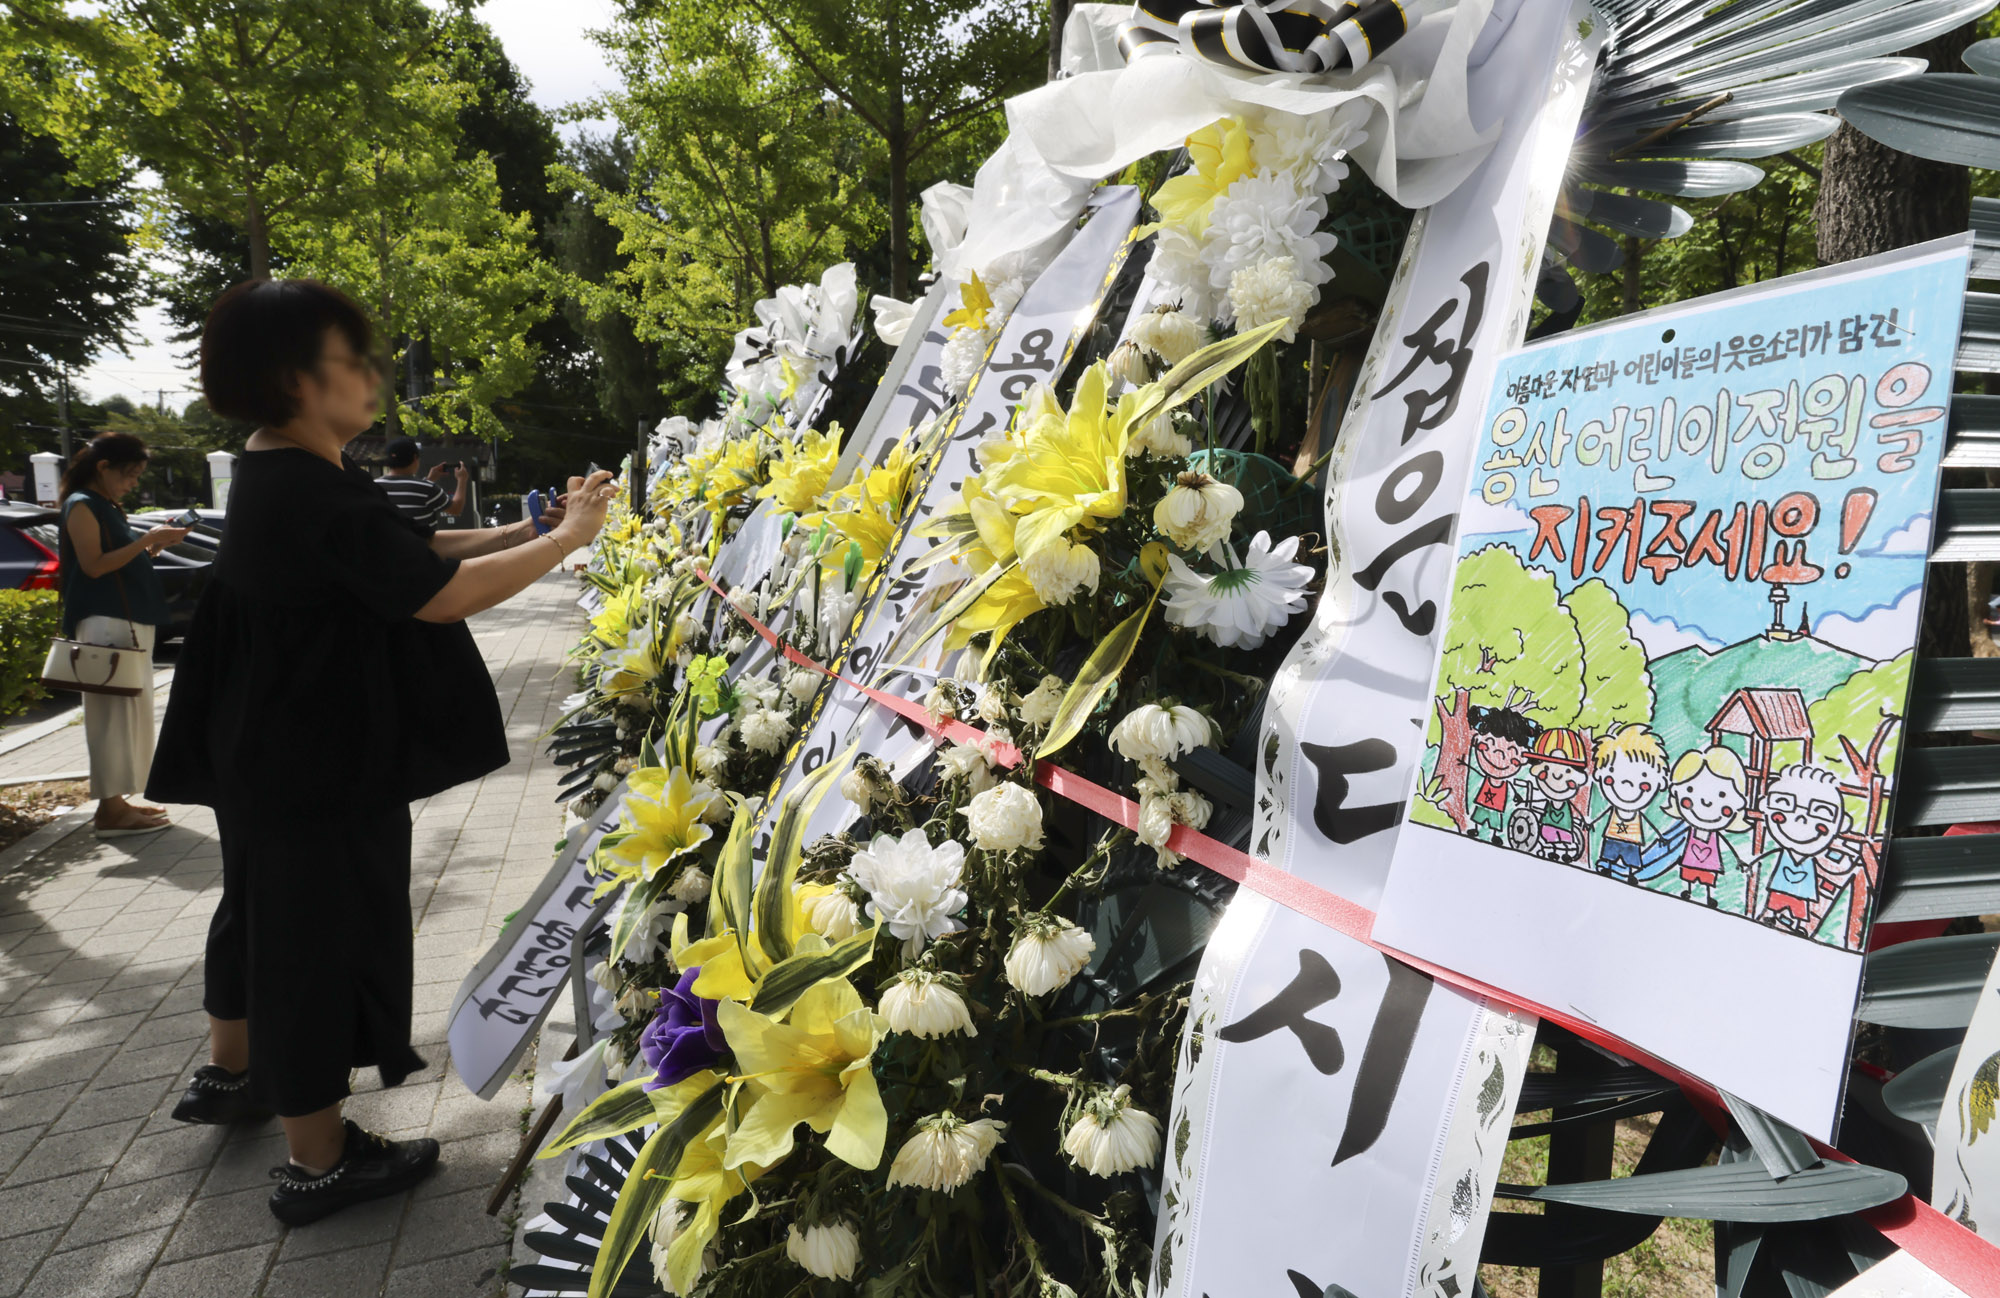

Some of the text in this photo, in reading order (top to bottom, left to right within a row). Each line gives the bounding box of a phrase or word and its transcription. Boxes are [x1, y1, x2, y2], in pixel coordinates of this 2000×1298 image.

[1558, 360, 1619, 394] 자연과
[1623, 341, 1721, 385] 어린이들의
[1721, 320, 1833, 373] 웃음소리가
[1838, 307, 1902, 355] 담긴
